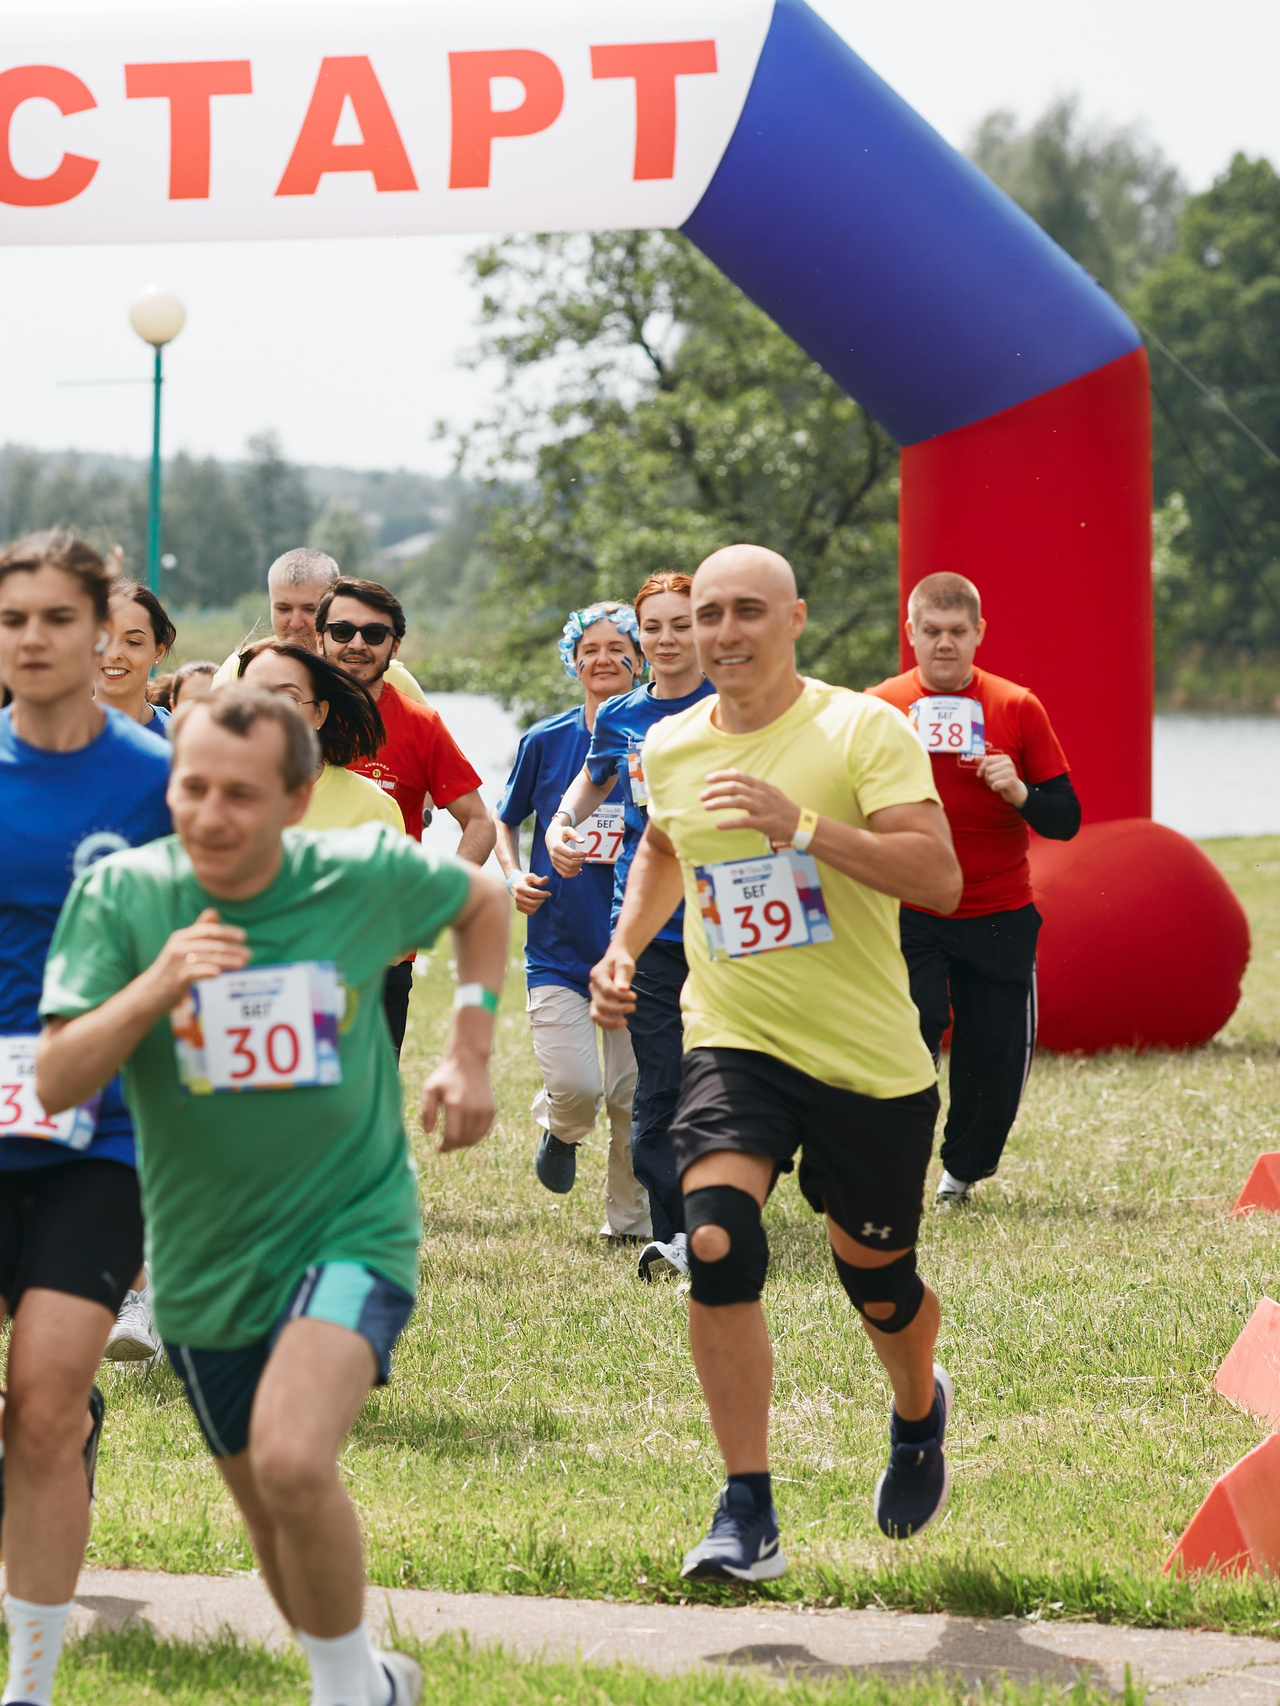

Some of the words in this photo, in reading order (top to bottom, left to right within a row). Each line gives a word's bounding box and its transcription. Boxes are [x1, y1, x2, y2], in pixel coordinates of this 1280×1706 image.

[937, 712, 954, 720] БЕГ
[928, 723, 963, 747] 38
[597, 819, 614, 829] БЕГ
[587, 831, 624, 859] 27
[742, 883, 767, 900] БЕГ
[733, 900, 791, 948] 39
[226, 1024, 300, 1079] 30
